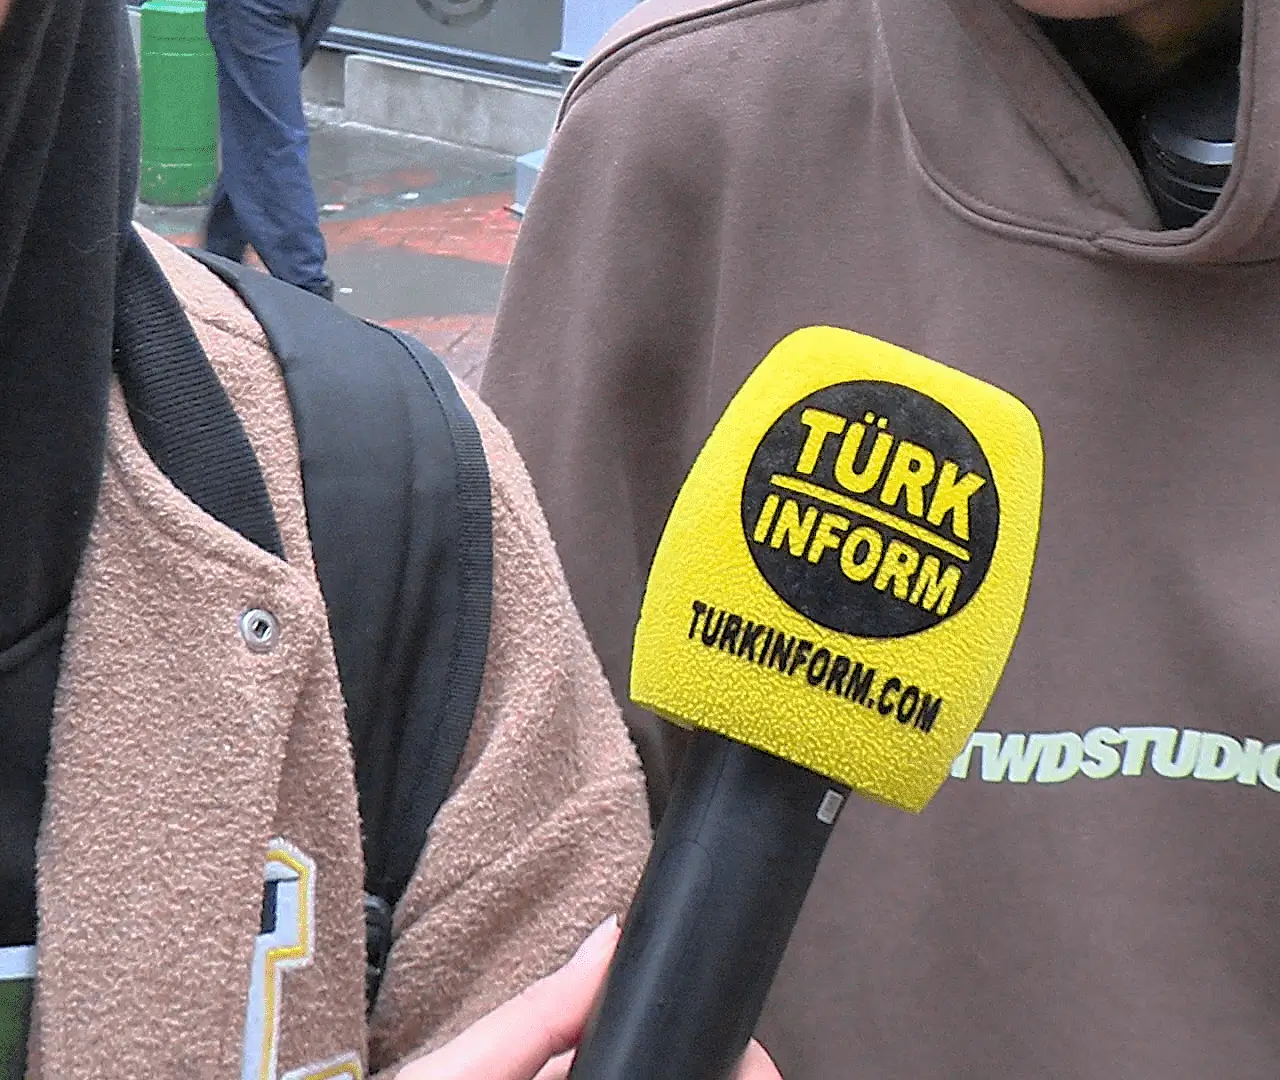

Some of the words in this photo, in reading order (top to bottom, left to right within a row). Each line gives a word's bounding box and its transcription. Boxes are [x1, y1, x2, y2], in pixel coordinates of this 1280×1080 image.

[795, 407, 987, 542] TÜRK
[753, 493, 962, 616] INFORM
[688, 600, 943, 733] TURKINFORM.COM
